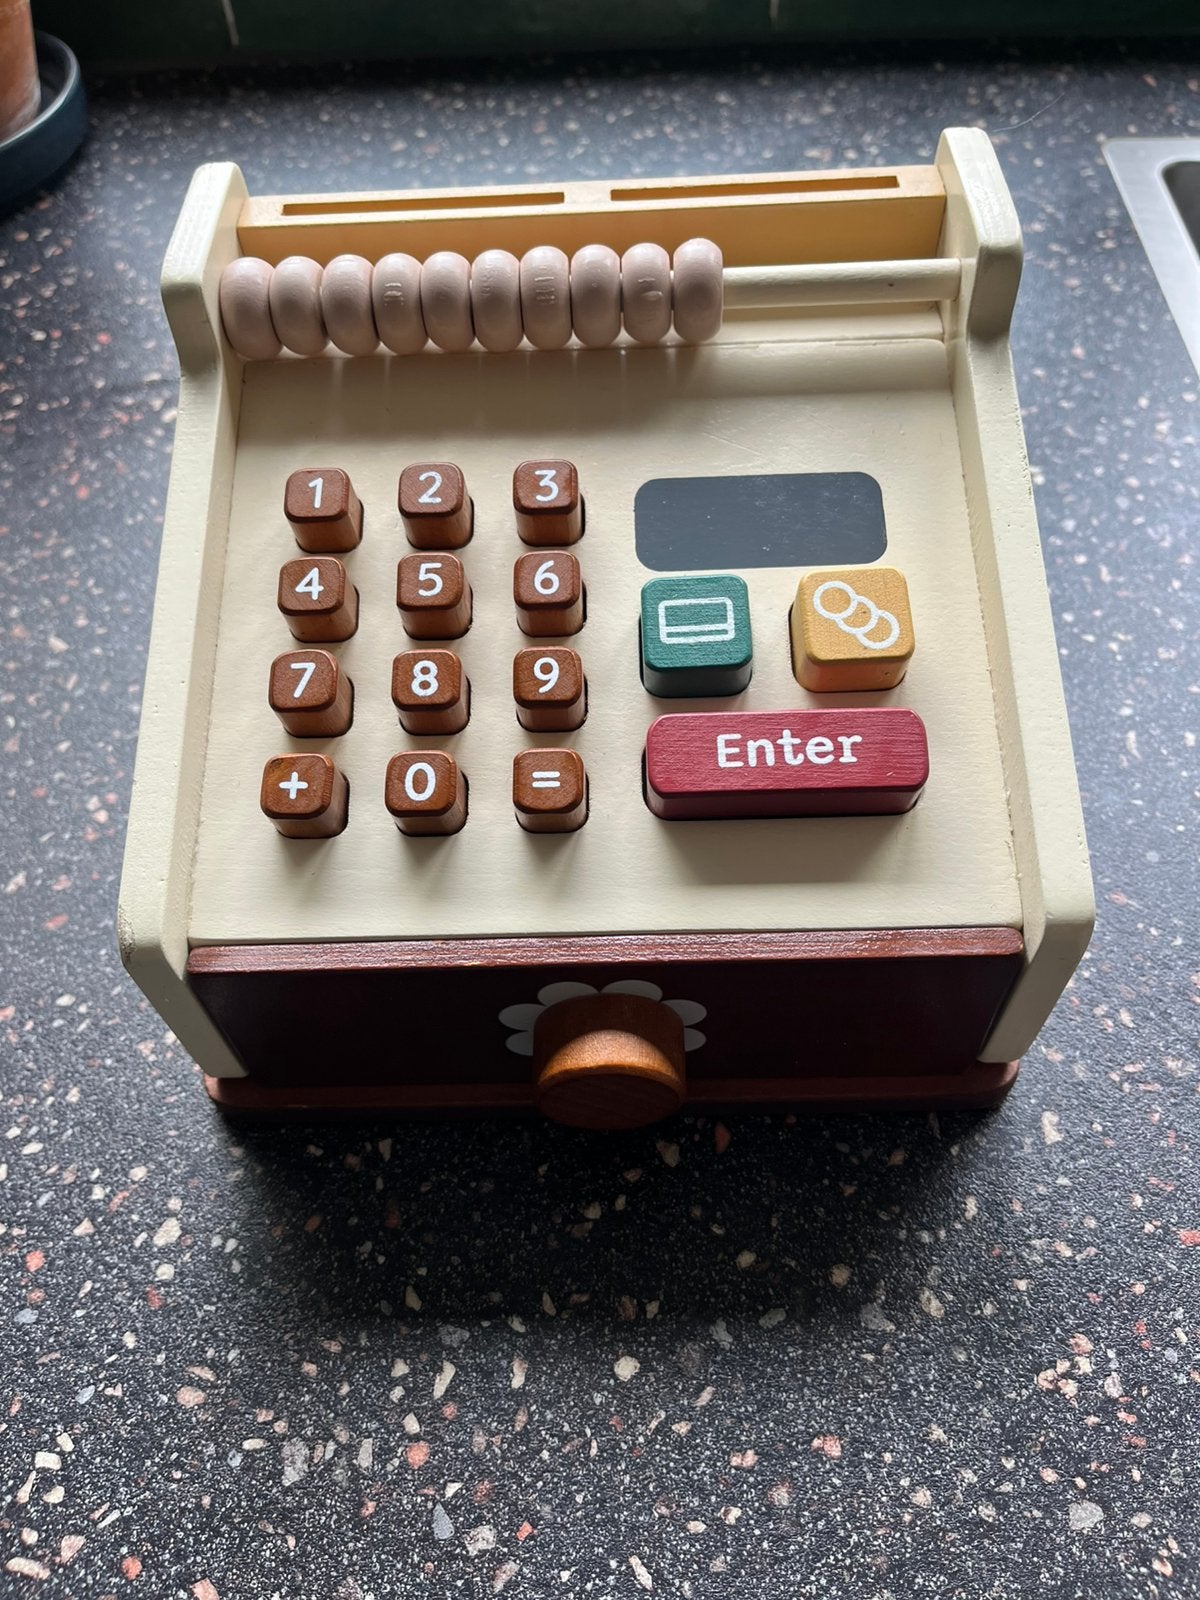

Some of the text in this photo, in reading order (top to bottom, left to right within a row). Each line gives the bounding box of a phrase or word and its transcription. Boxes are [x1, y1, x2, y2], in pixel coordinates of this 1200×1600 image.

[308, 477, 323, 509] 1
[418, 471, 442, 504] 2
[534, 469, 559, 502] 3
[295, 567, 324, 600] 4
[418, 562, 443, 597] 5
[533, 560, 560, 595] 6
[290, 662, 316, 698] 7
[410, 660, 439, 697] 8
[533, 657, 560, 693] 9
[716, 729, 863, 769] Enter
[279, 771, 309, 800] +
[404, 762, 437, 801] 0
[531, 771, 561, 787] =
